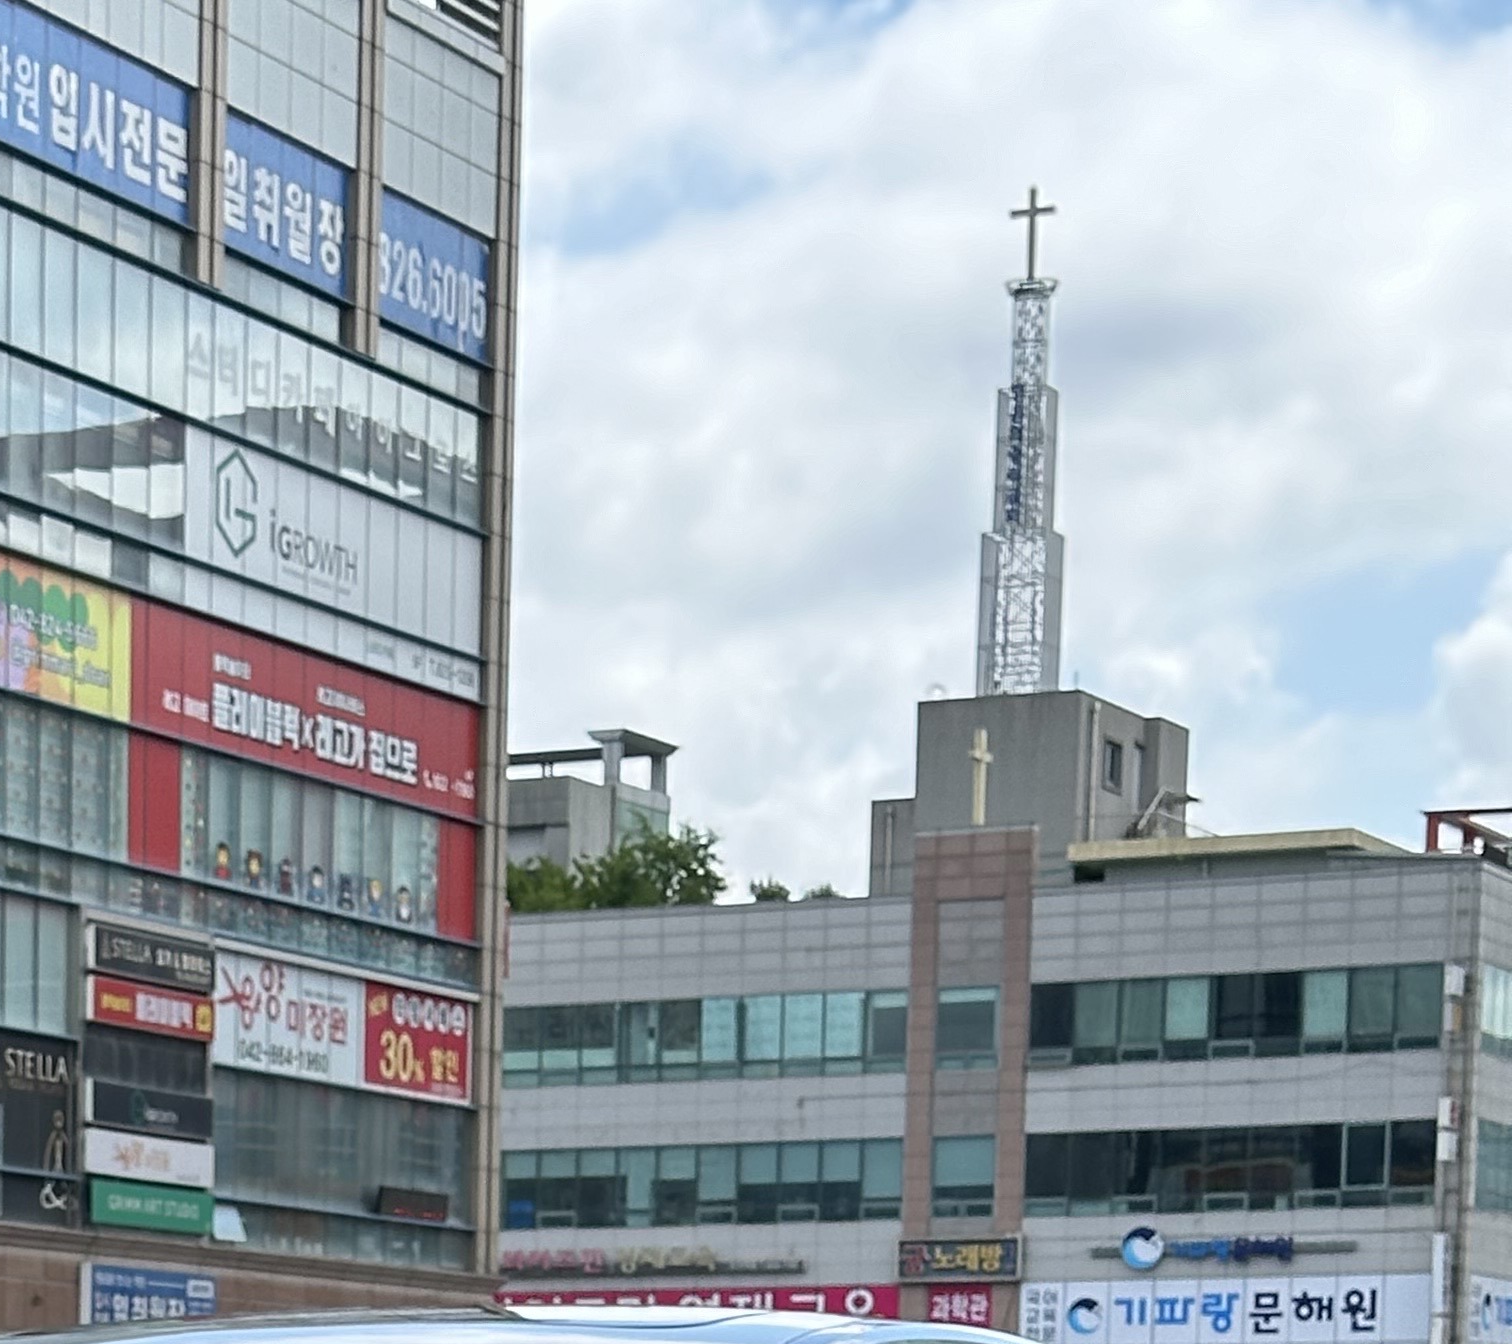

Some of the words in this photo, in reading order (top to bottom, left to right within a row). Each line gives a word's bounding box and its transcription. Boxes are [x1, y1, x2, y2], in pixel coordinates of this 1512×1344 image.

[48, 62, 187, 203] 입시전문
[224, 149, 344, 277] 일취월장
[4, 1047, 68, 1084] STELLA
[1114, 1293, 1239, 1333] 기파랑
[1250, 1287, 1378, 1334] 문해원
